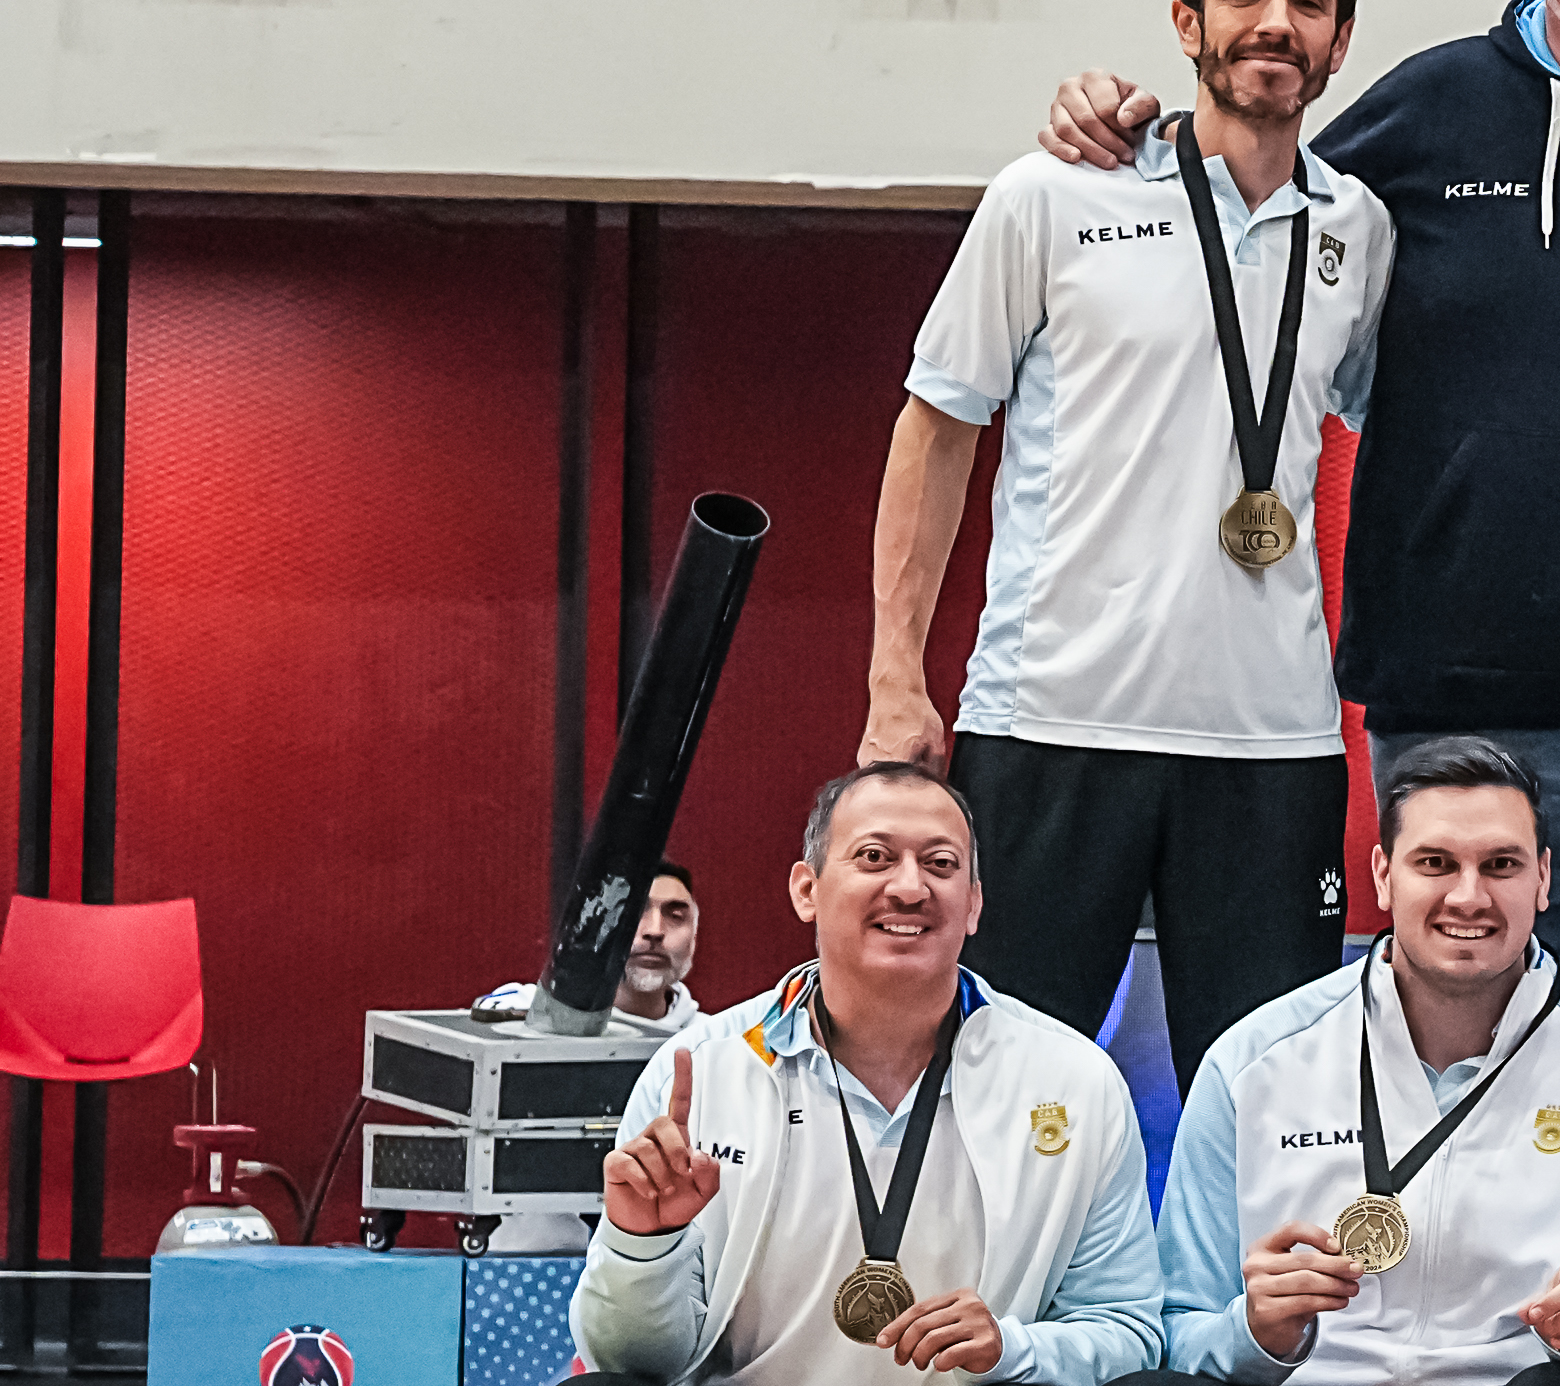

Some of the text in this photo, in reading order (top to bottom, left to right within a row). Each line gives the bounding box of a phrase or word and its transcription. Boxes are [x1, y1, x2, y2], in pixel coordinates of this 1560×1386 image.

[1445, 181, 1530, 199] KELME
[1078, 221, 1174, 245] KELME
[1240, 510, 1277, 527] CHILE
